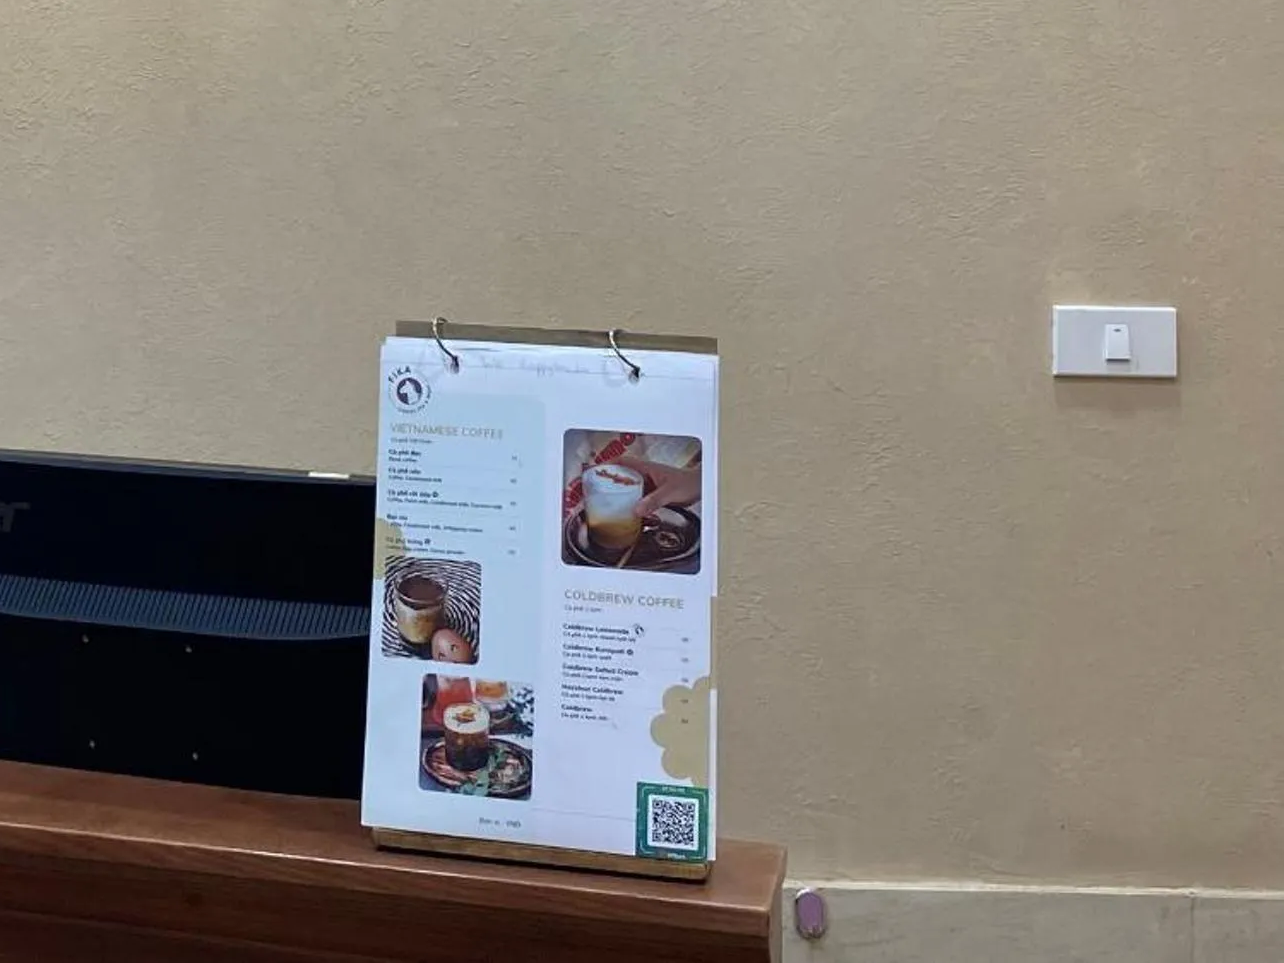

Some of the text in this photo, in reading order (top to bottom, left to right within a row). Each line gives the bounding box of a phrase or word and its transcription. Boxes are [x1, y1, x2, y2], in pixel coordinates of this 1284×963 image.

[390, 422, 504, 440] VIETNAMESE COFFEE
[564, 588, 685, 610] COLDBREW COFFEE
